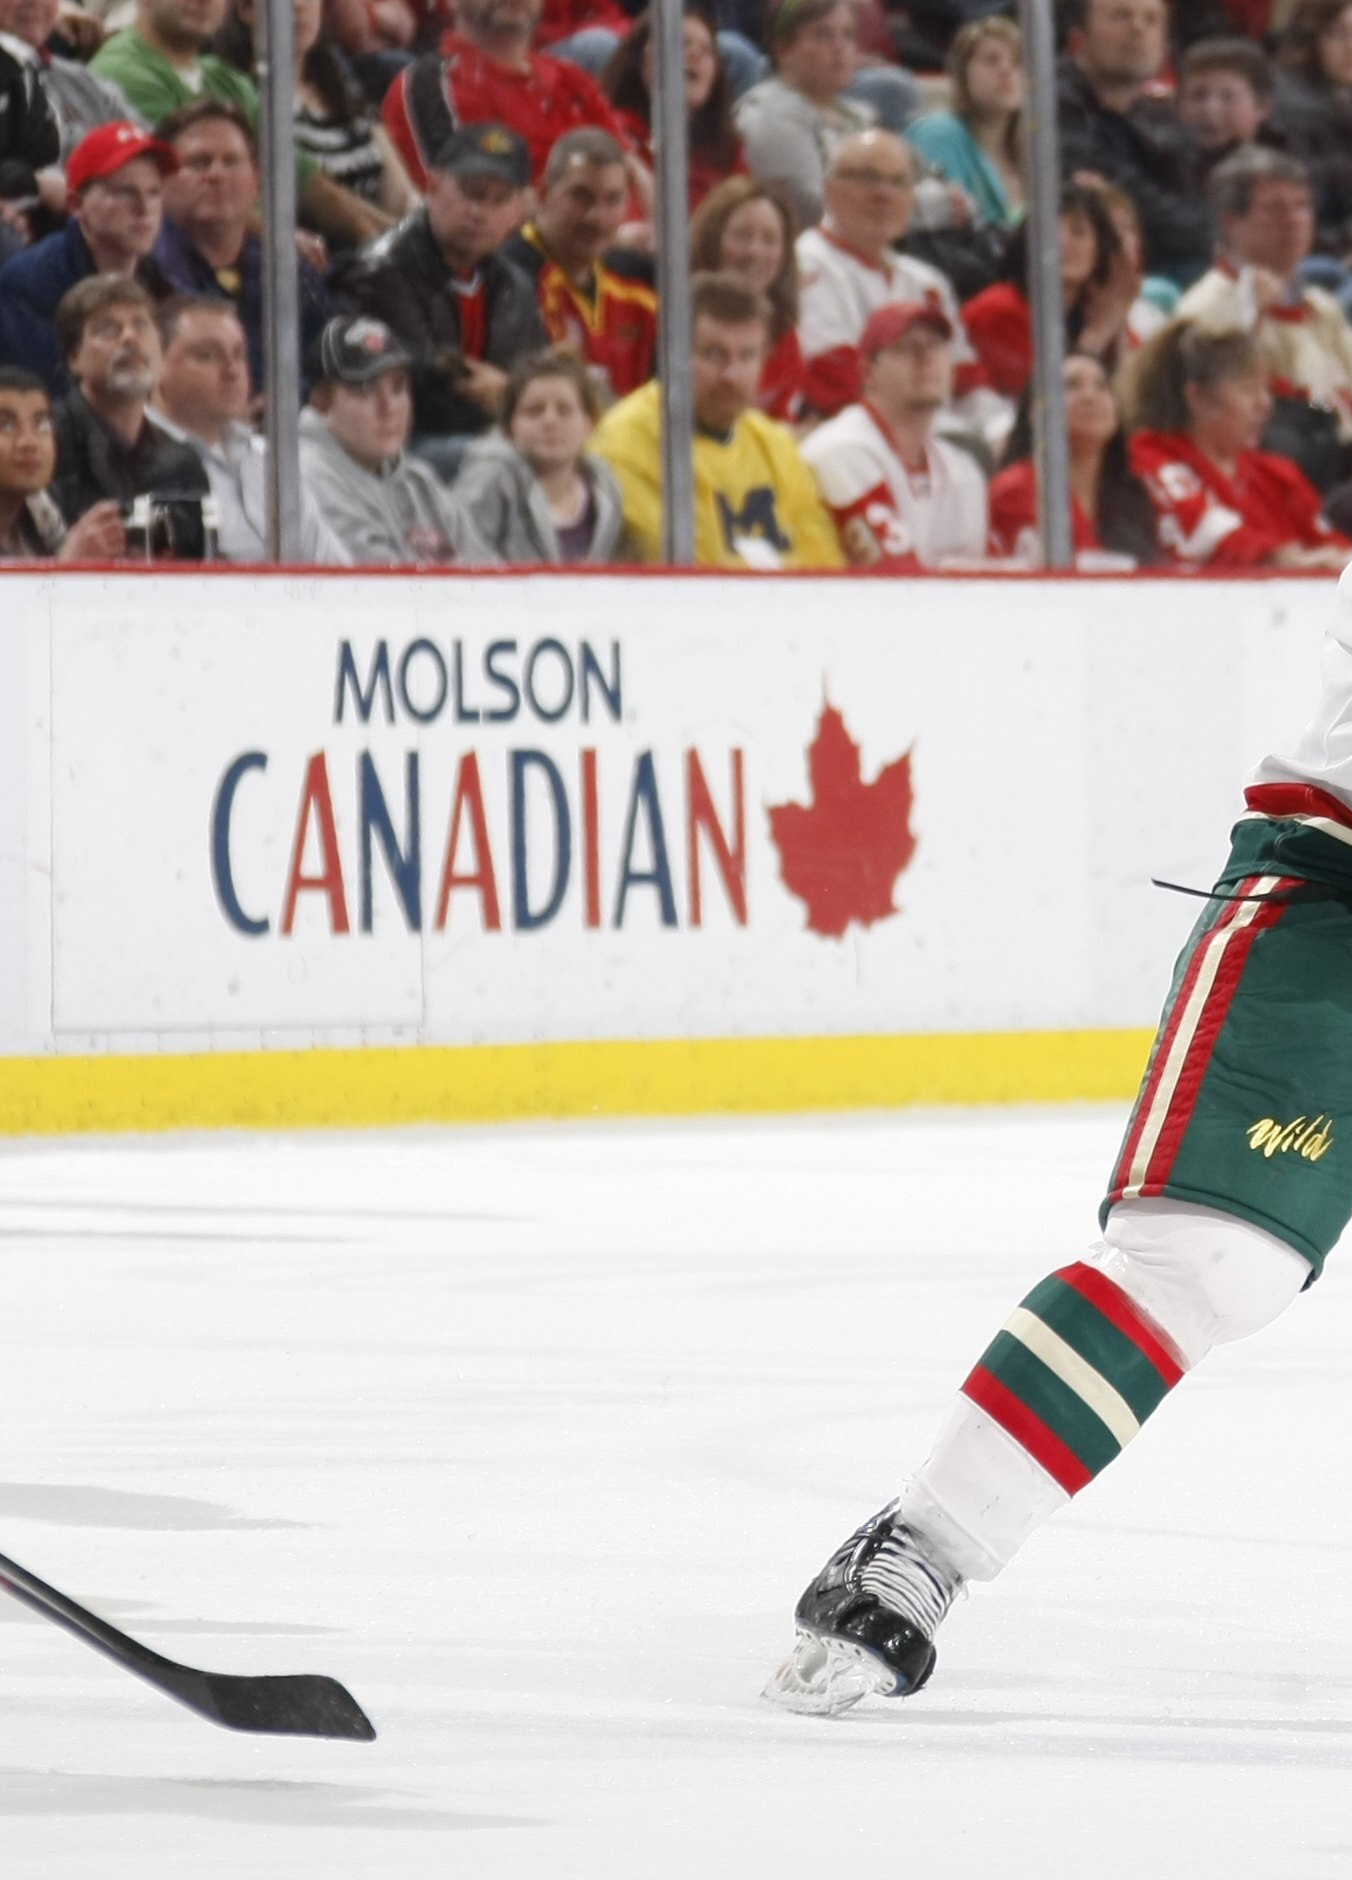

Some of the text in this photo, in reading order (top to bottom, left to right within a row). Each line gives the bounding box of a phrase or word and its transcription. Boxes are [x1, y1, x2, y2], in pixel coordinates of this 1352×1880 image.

[332, 637, 622, 726] MOLSON
[208, 746, 750, 938] CANADIAN
[1247, 1115, 1334, 1162] Wild
